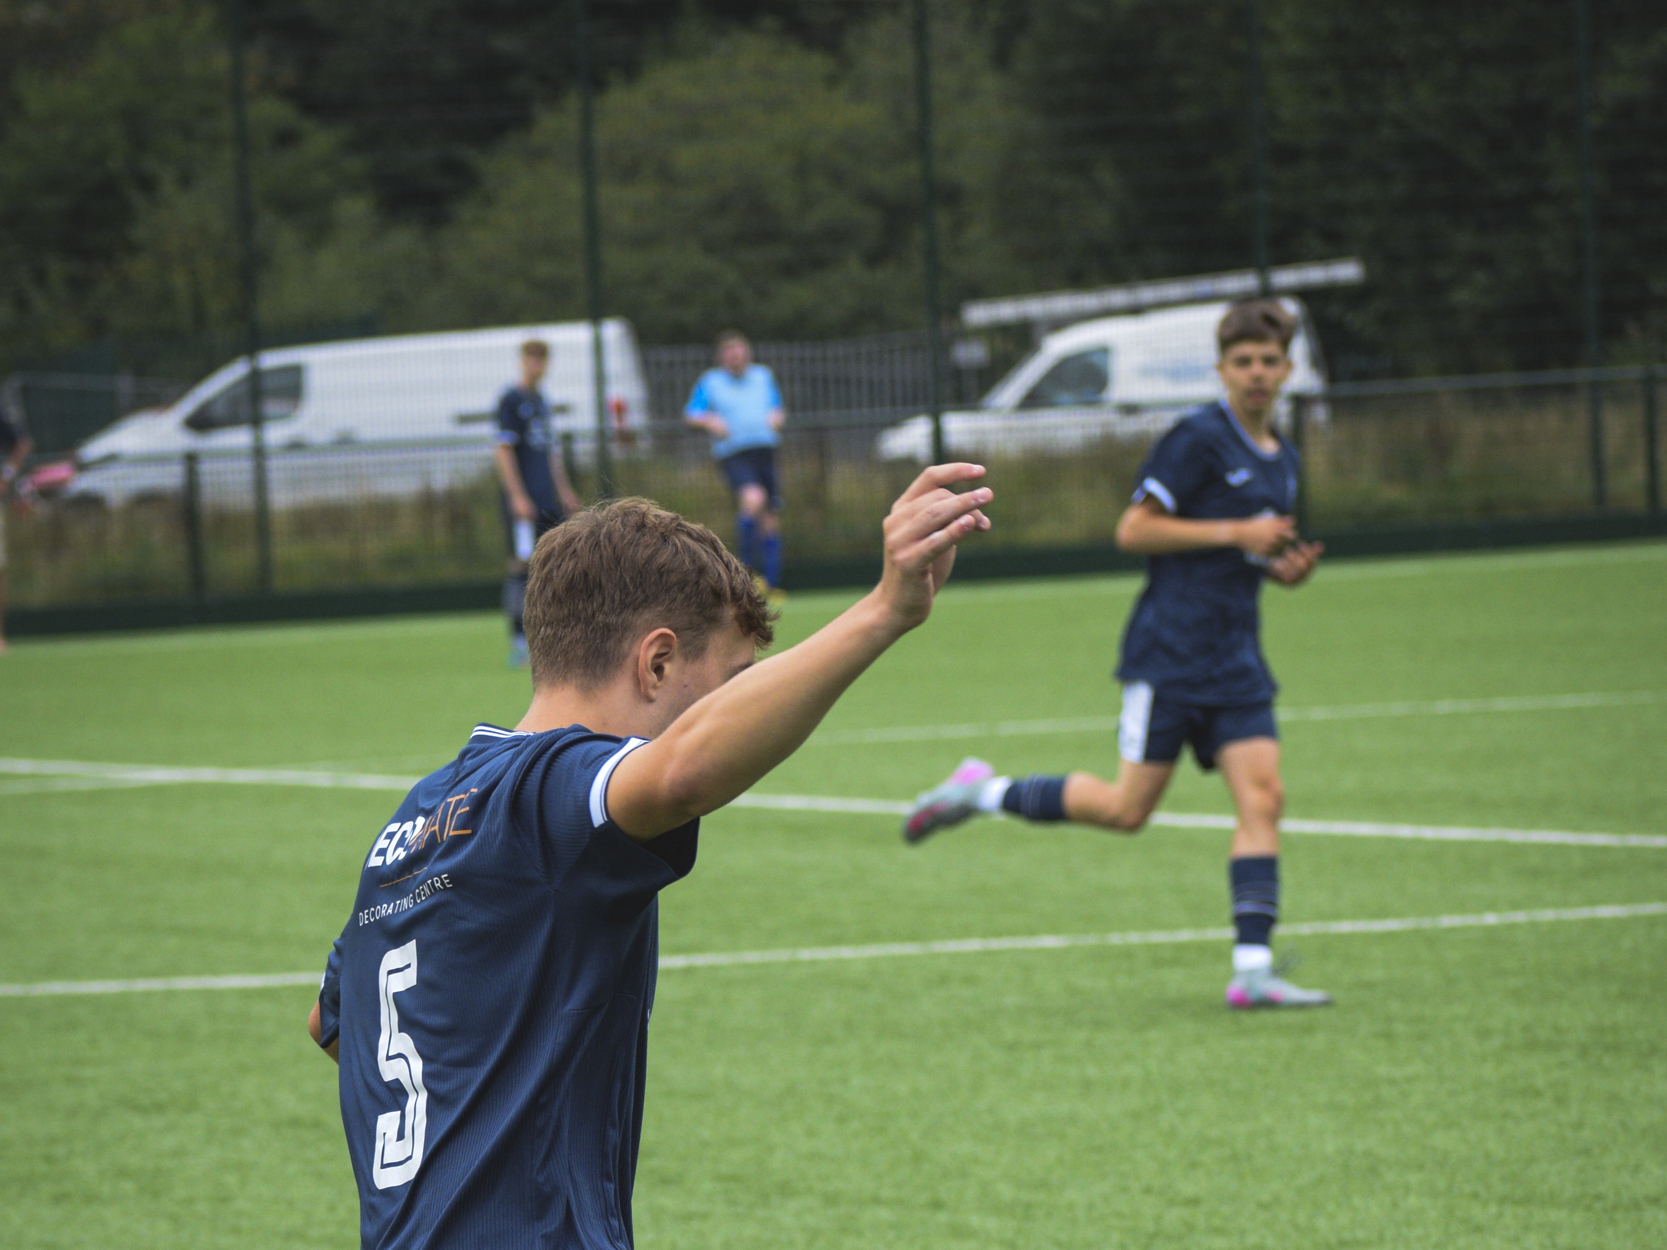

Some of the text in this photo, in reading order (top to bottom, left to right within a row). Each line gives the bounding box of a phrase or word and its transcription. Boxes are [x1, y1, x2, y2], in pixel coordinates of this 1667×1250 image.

[358, 873, 453, 927] DECORATING CENTRE
[366, 938, 428, 1190] 5
